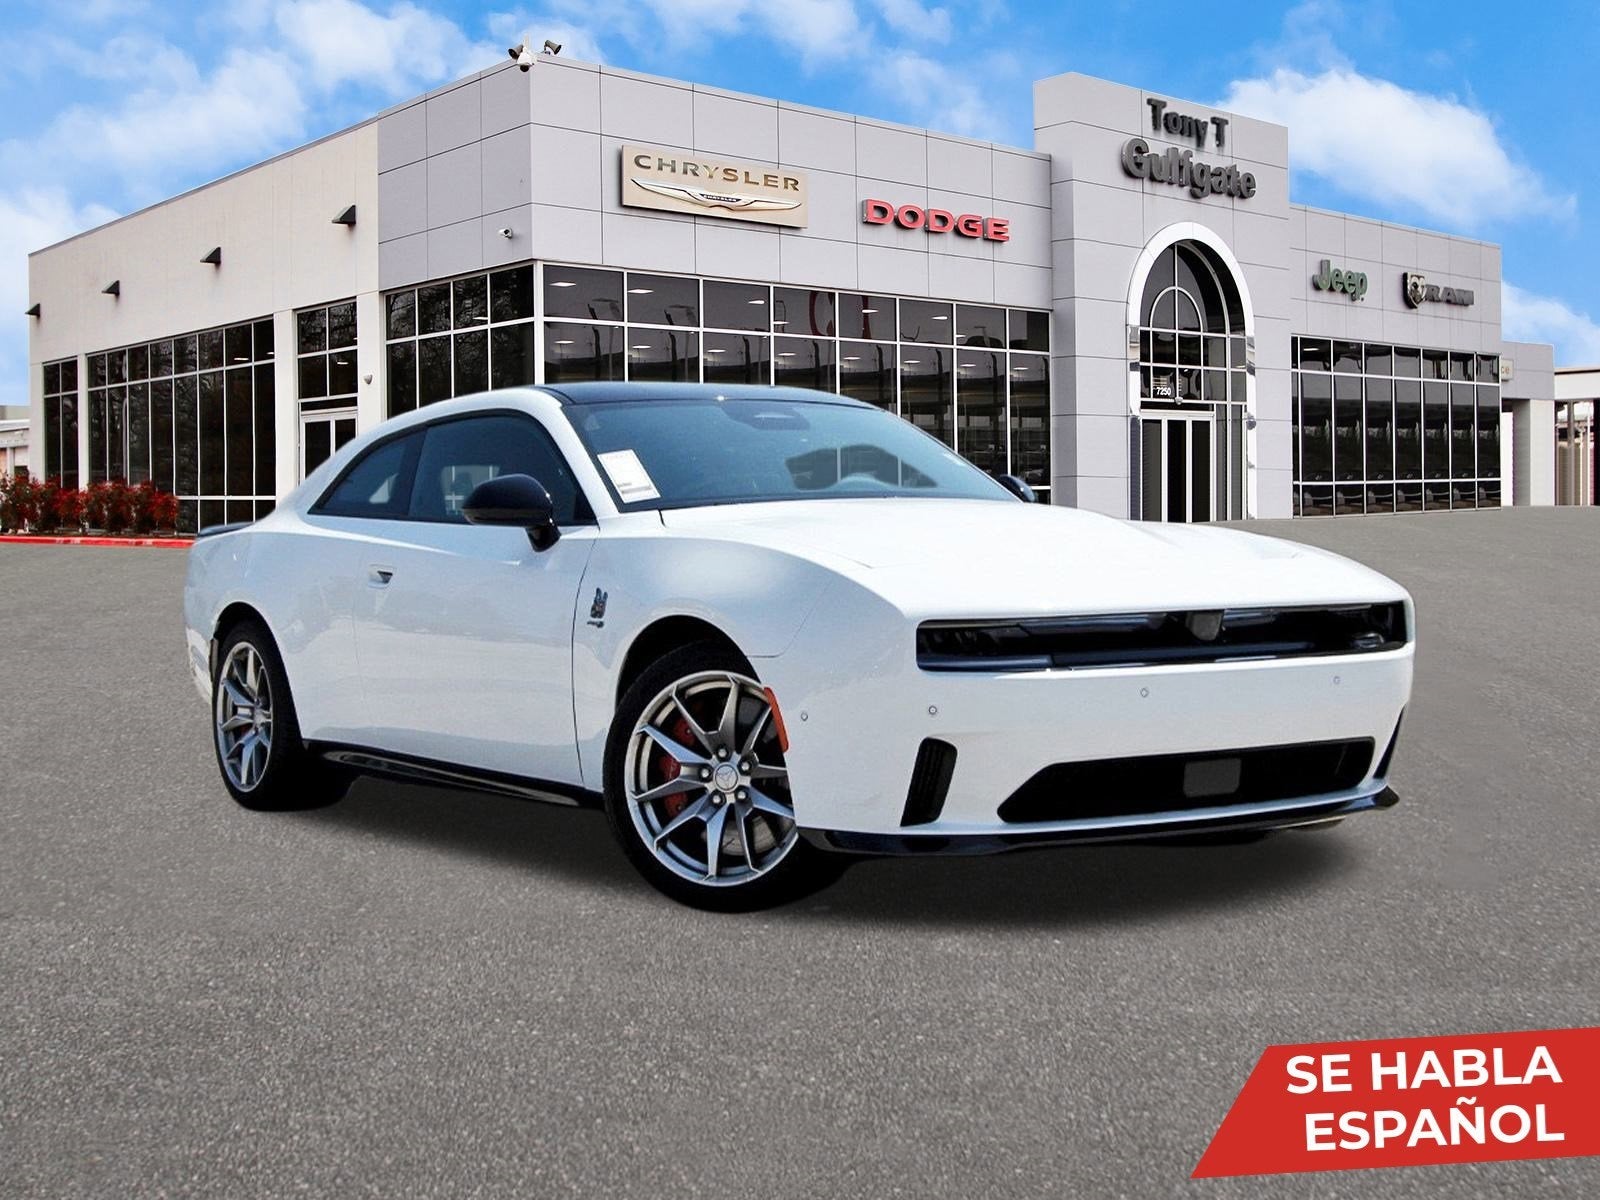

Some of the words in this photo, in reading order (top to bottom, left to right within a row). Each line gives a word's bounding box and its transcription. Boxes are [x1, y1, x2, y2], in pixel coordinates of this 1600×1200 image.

[1147, 98, 1208, 147] Tony
[1211, 117, 1229, 147] T
[634, 155, 800, 191] CHRYSLER
[1122, 138, 1256, 199] Gulfgate
[863, 199, 1010, 242] DODGE
[1312, 260, 1368, 301] Jeep
[1425, 284, 1474, 307] RAM
[1156, 387, 1171, 396] 7250
